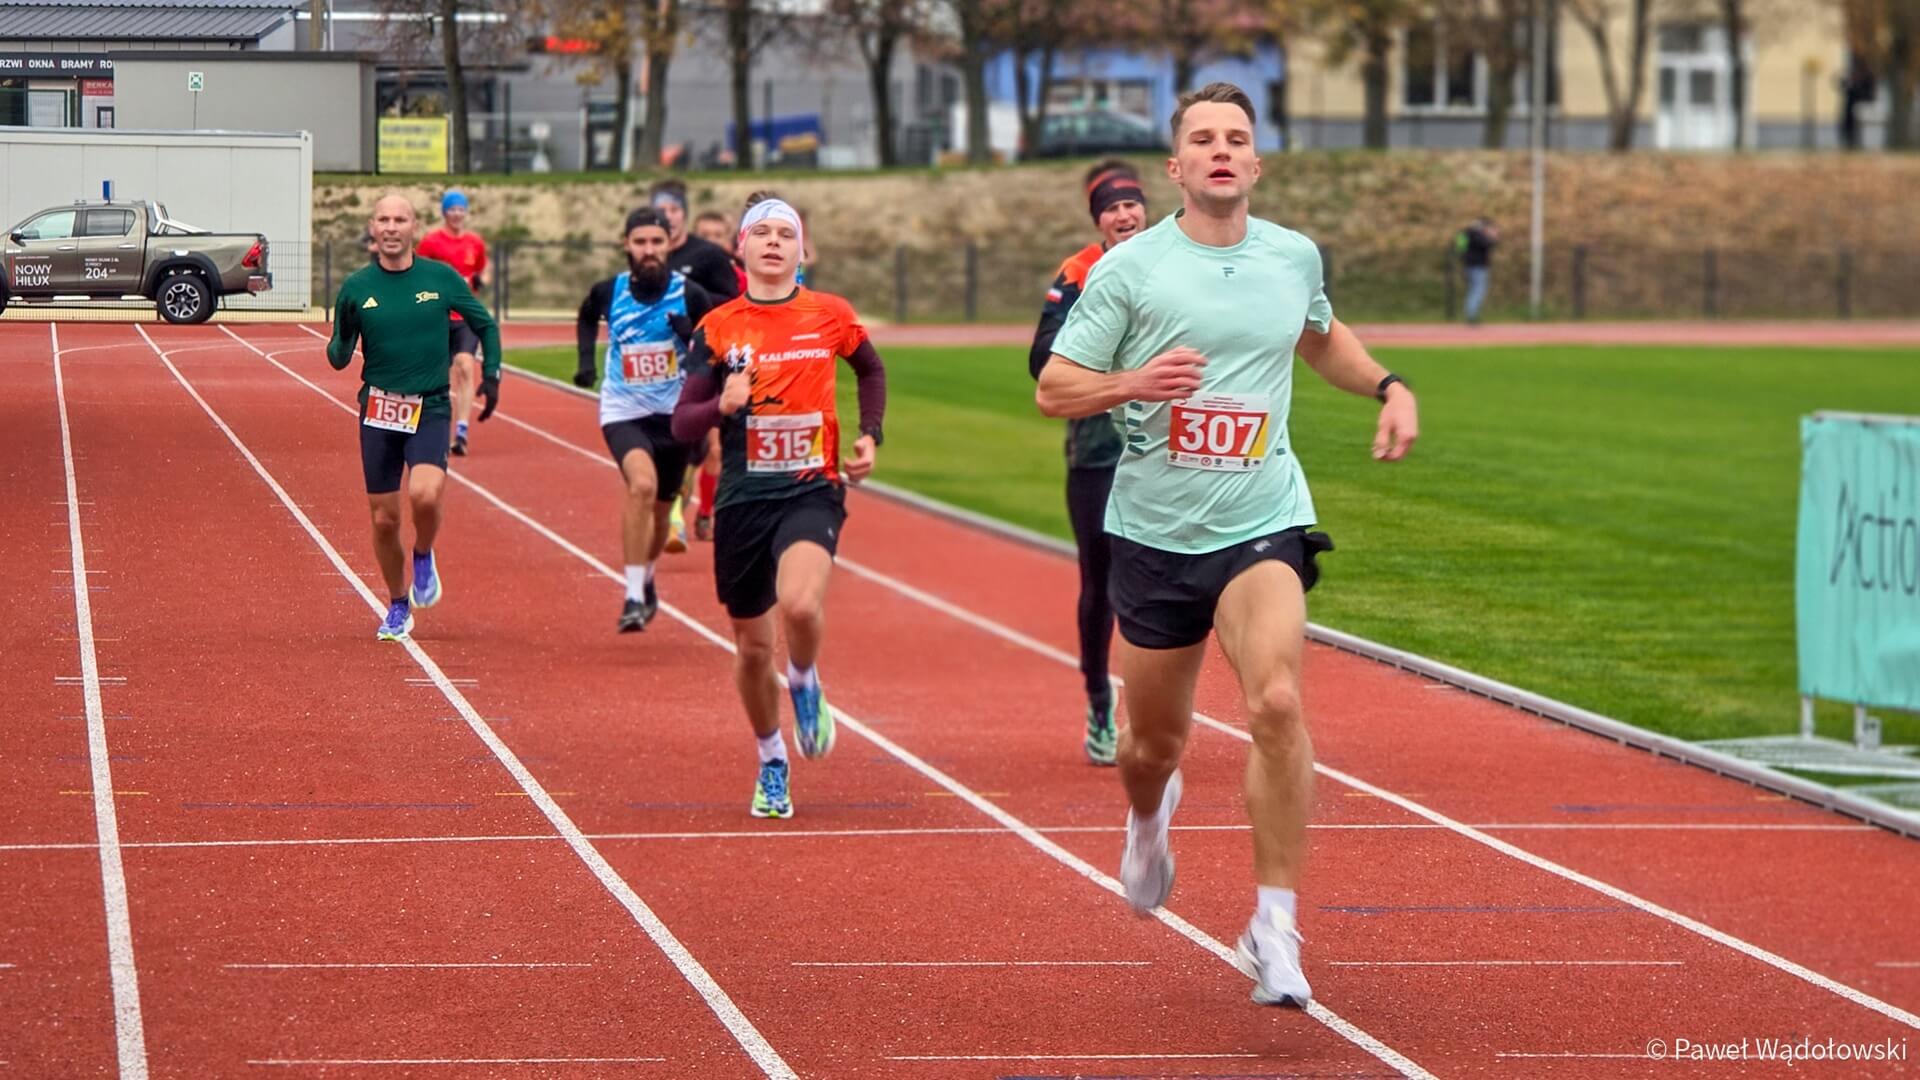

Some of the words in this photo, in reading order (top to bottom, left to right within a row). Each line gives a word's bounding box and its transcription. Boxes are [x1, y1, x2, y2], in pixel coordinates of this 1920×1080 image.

[29, 60, 54, 68] OKNA
[61, 60, 94, 68] BRAMY
[15, 264, 52, 275] NOWY
[84, 267, 108, 279] 204
[15, 275, 50, 287] HILUX
[759, 349, 830, 362] KALINOWSKI
[629, 353, 669, 377] 168
[375, 398, 413, 424] 150
[1178, 411, 1263, 454] 307
[757, 429, 812, 460] 315
